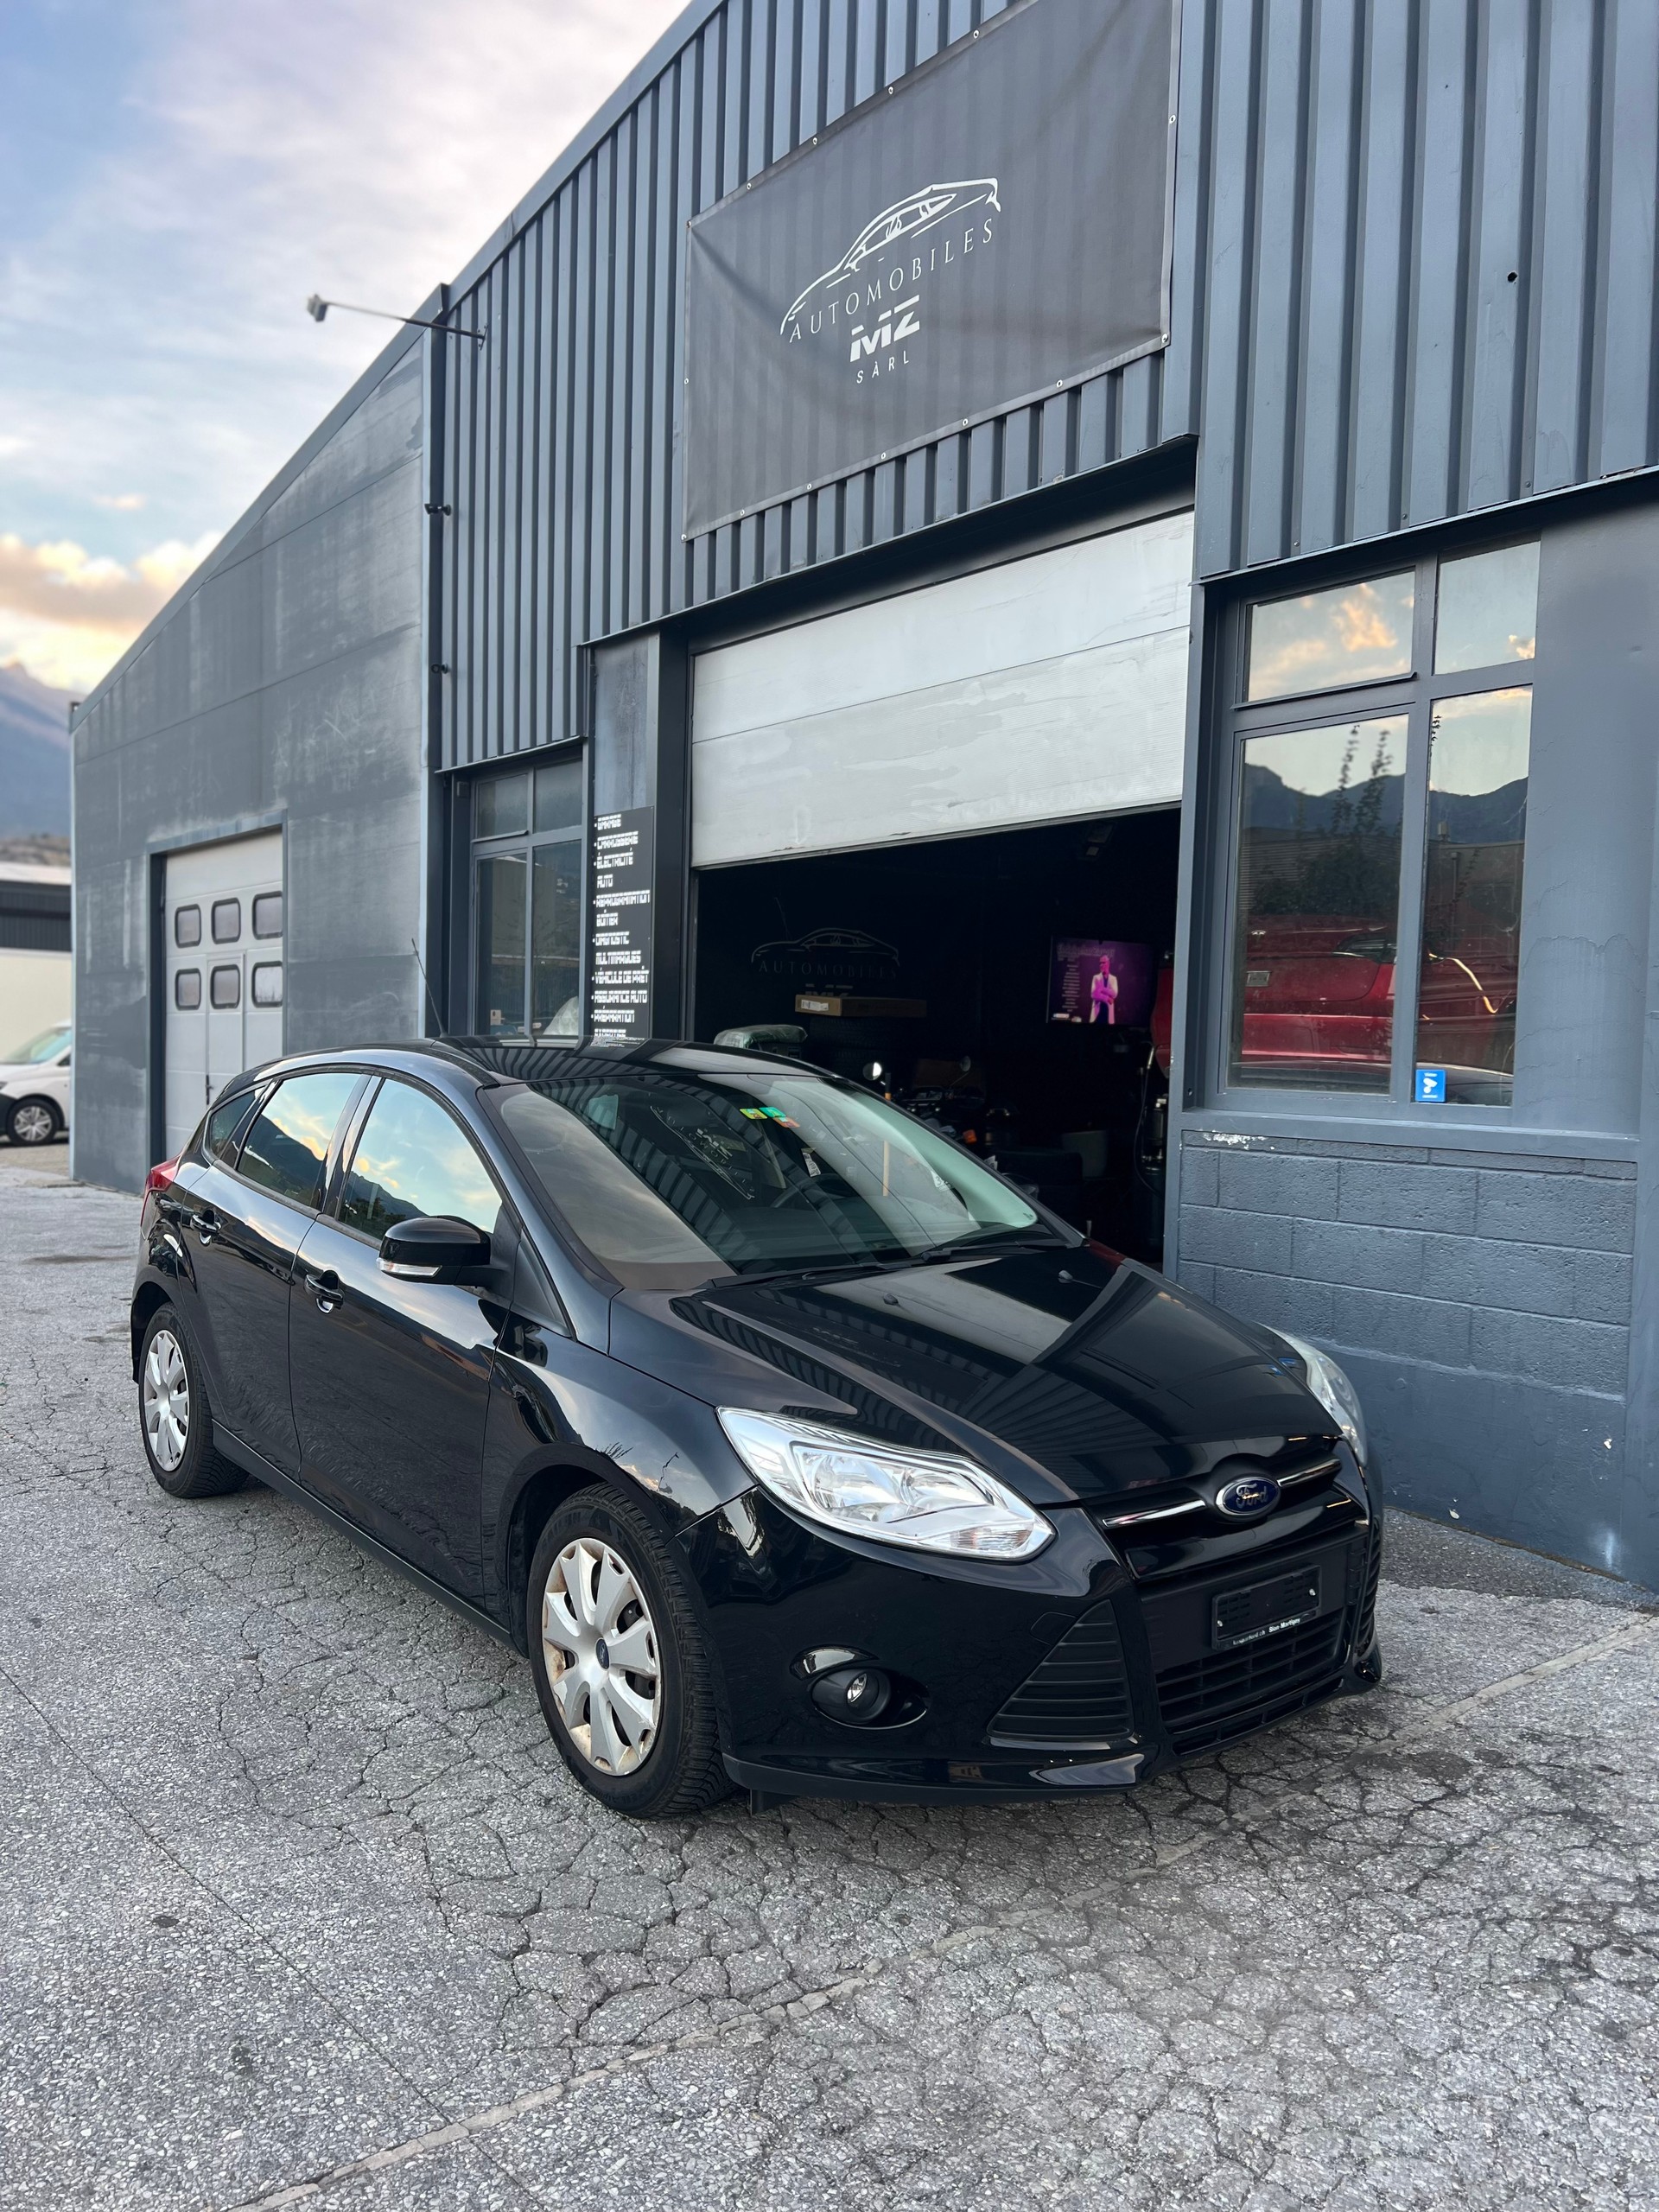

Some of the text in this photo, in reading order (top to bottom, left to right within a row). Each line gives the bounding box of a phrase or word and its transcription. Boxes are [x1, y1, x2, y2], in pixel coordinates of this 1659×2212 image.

[789, 218, 994, 343] AUTOMOBILES
[849, 295, 920, 362] MZ
[597, 830, 639, 849] CARROSSERIE
[596, 847, 633, 869] ÉLECTRICITÉ
[597, 874, 613, 888] AUTO
[595, 950, 641, 965] MULTIMARQUES
[623, 970, 632, 983] DE
[758, 960, 897, 980] AUTOMOBILES
[1236, 1484, 1268, 1508] Ford
